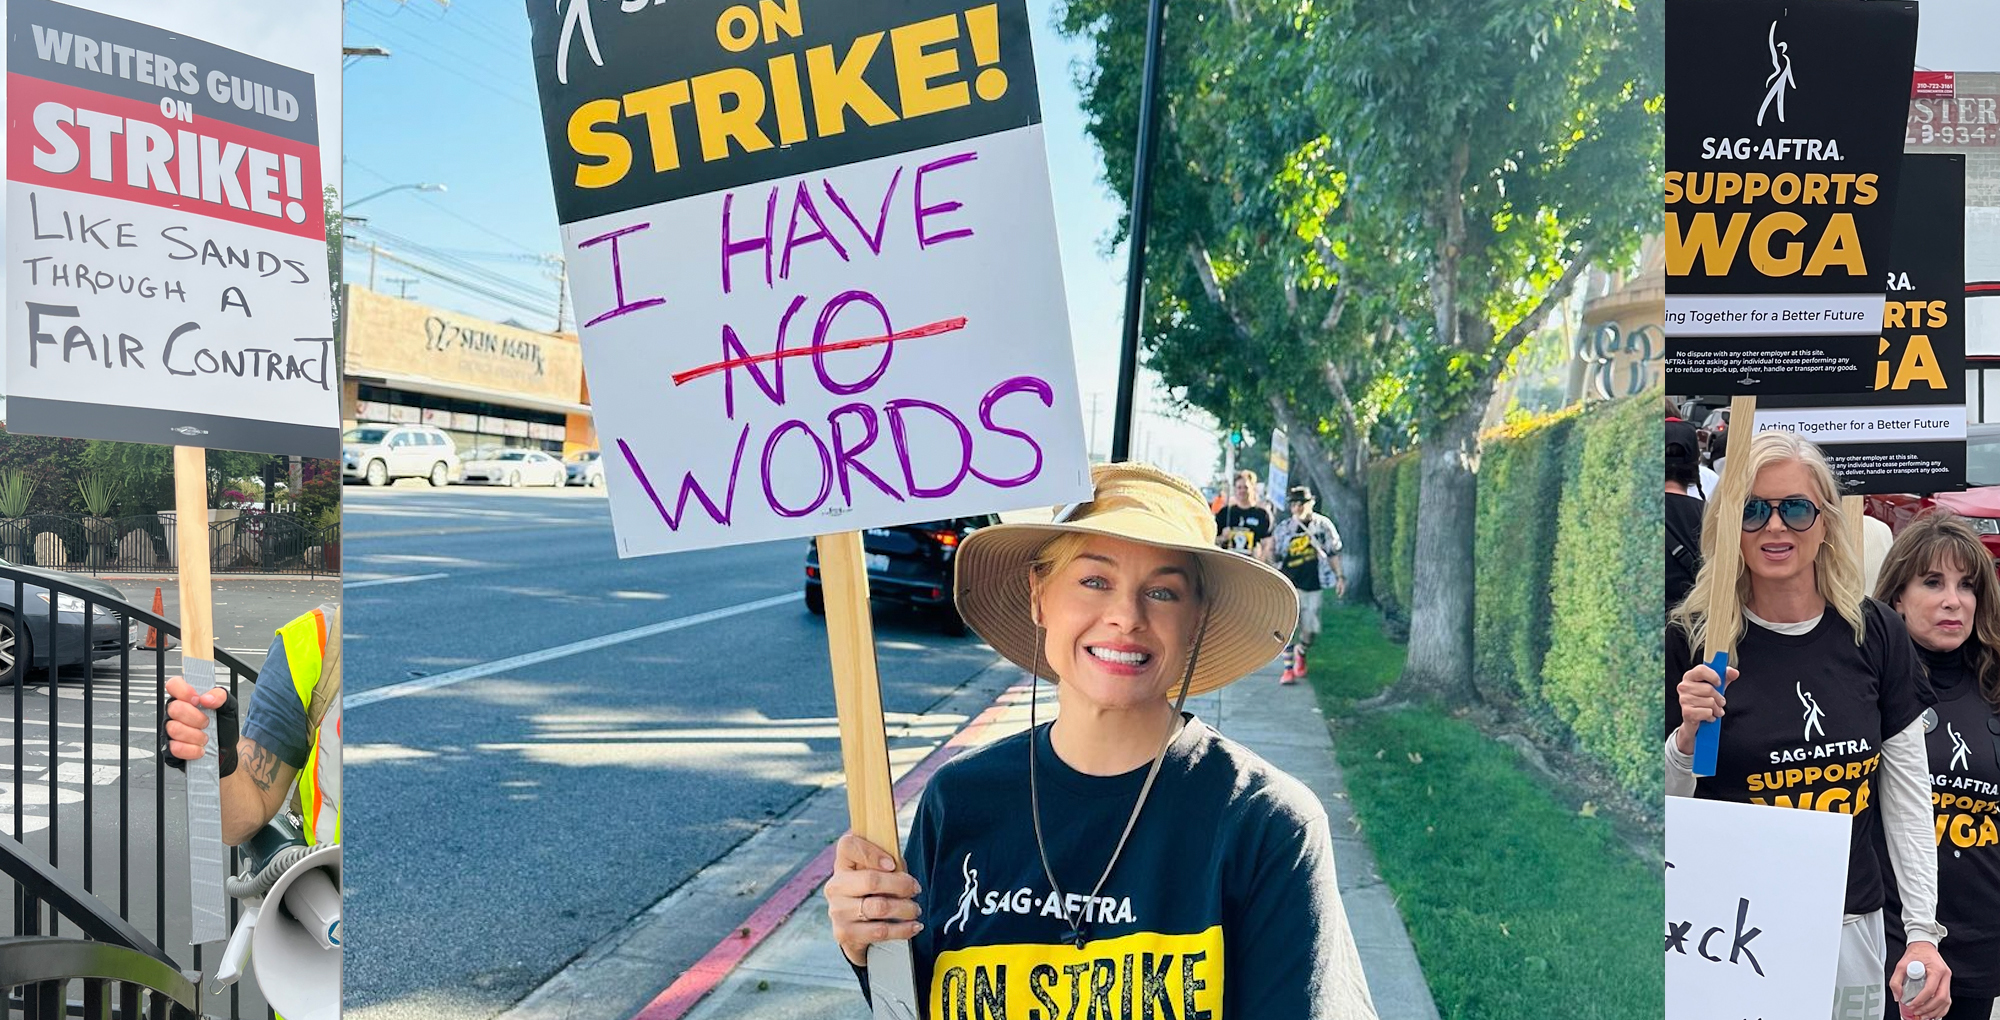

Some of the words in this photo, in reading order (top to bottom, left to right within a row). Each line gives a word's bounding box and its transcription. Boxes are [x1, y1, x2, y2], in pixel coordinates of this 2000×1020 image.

[716, 0, 803, 52] ON
[31, 24, 200, 95] WRITERS
[207, 70, 299, 122] GUILD
[567, 4, 1008, 189] STRIKE!
[160, 97, 192, 123] ON
[1908, 98, 1999, 124] STER
[33, 102, 306, 224] STRIKE!
[1665, 171, 1879, 205] SUPPORTS
[30, 192, 138, 249] LIKE
[160, 225, 310, 284] SANDS
[578, 223, 666, 328] I
[721, 152, 977, 294] HAVE
[1665, 211, 1868, 277] WGA
[23, 256, 186, 302] THROUGH
[220, 286, 252, 318] A
[25, 301, 145, 369] FAIR
[1690, 310, 1748, 324] Together
[1751, 310, 1768, 321] for
[1771, 312, 1778, 321] a
[1782, 310, 1821, 321] Better
[1824, 309, 1865, 321] Future
[723, 291, 893, 420] NO
[1706, 358, 1729, 366] asking
[1801, 357, 1837, 365] performing
[1713, 366, 1727, 374] pick
[1837, 364, 1858, 372] goods.
[1760, 350, 1790, 358] employer
[616, 376, 1053, 532] WORDS
[1759, 422, 1795, 433] Acting
[1798, 421, 1847, 433] Together
[1850, 420, 1865, 430] for
[1877, 420, 1911, 429] Better
[1914, 419, 1950, 429] Future
[1898, 460, 1930, 468] performing
[1747, 752, 1881, 791] SUPPORTS
[941, 965, 1006, 1020] ON
[1030, 950, 1211, 1020] STRIKE
